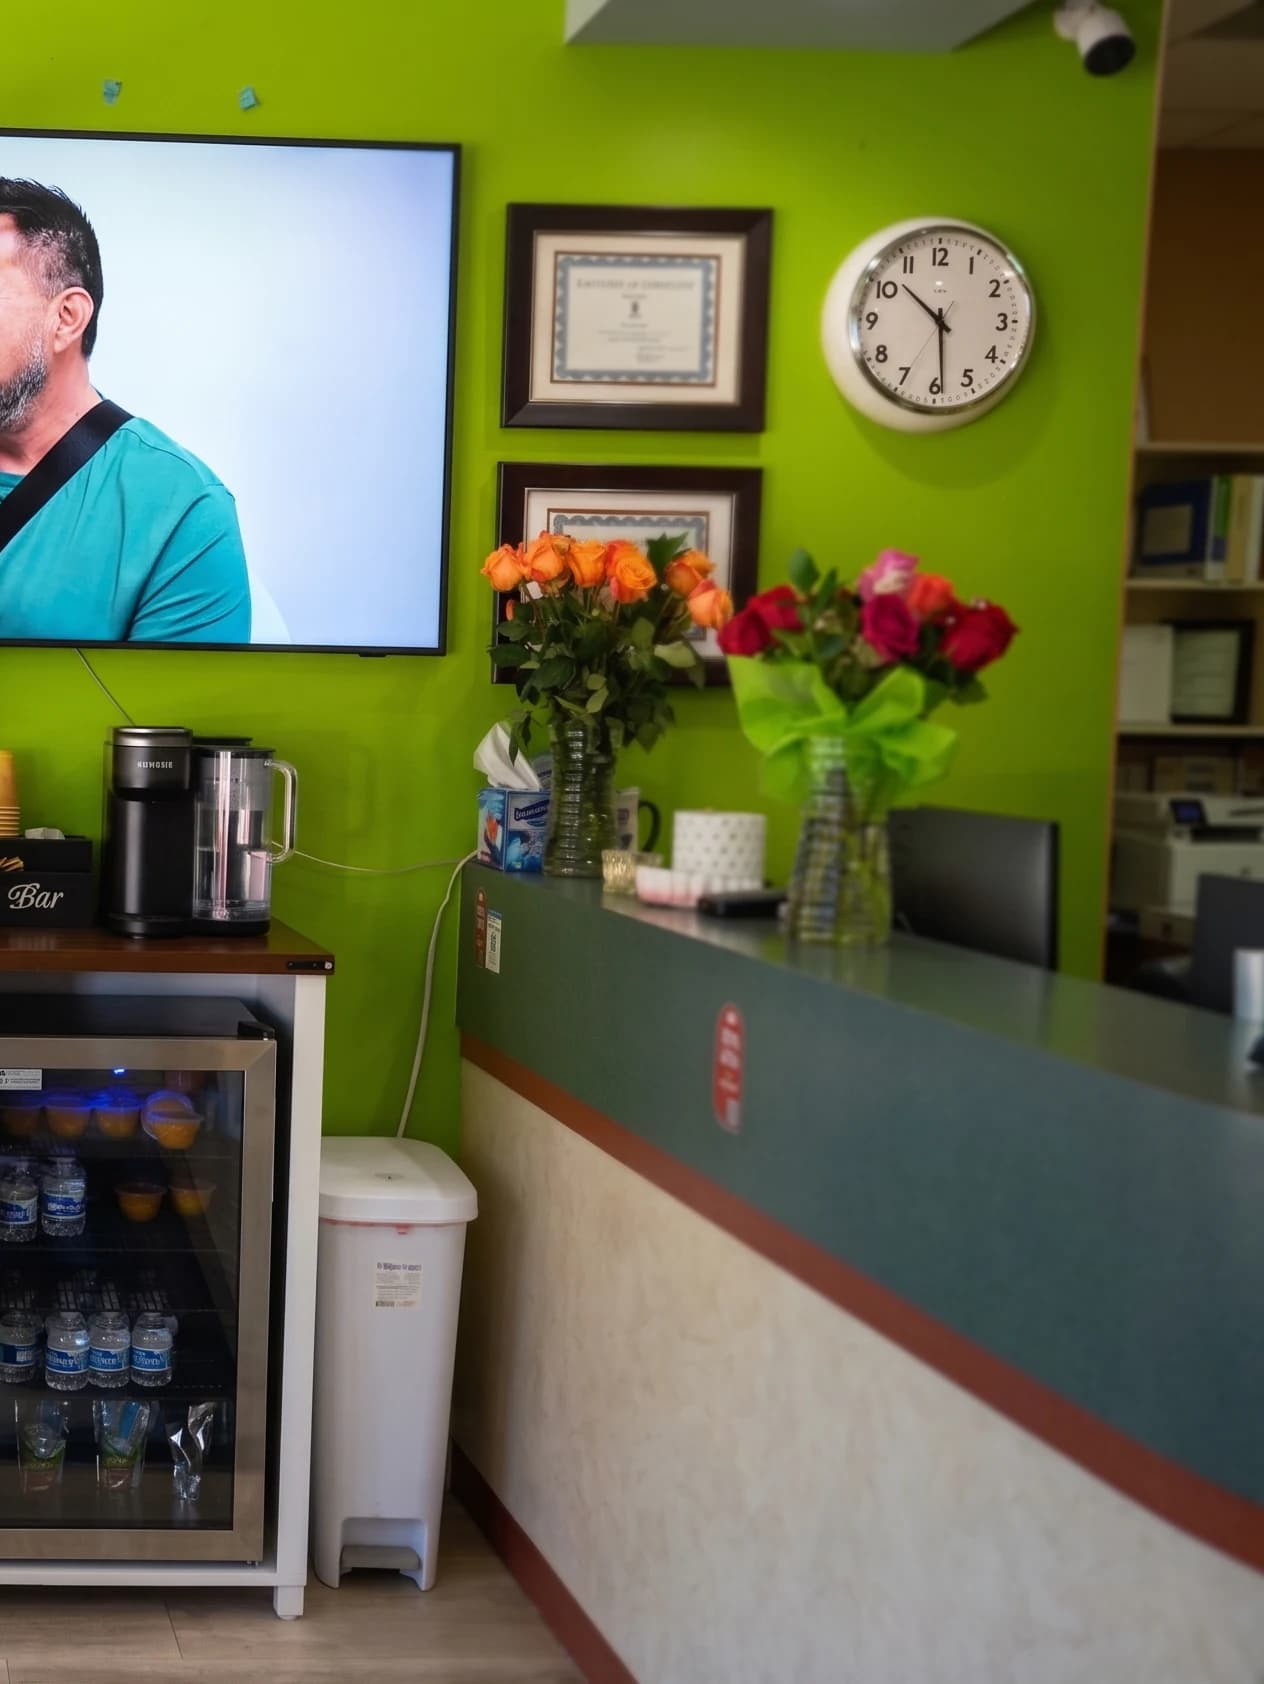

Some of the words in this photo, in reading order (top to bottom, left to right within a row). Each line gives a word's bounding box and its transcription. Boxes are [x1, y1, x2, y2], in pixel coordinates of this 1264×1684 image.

[903, 256, 914, 274] 11
[932, 247, 949, 266] 12
[969, 256, 974, 274] 1
[876, 280, 898, 299] 10
[989, 279, 1001, 298] 2
[865, 312, 879, 330] 9
[995, 313, 1008, 331] 3
[875, 345, 888, 363] 8
[985, 345, 999, 363] 4
[898, 367, 911, 385] 7
[960, 368, 974, 387] 5
[929, 377, 941, 395] 6
[7, 883, 64, 909] Bar
